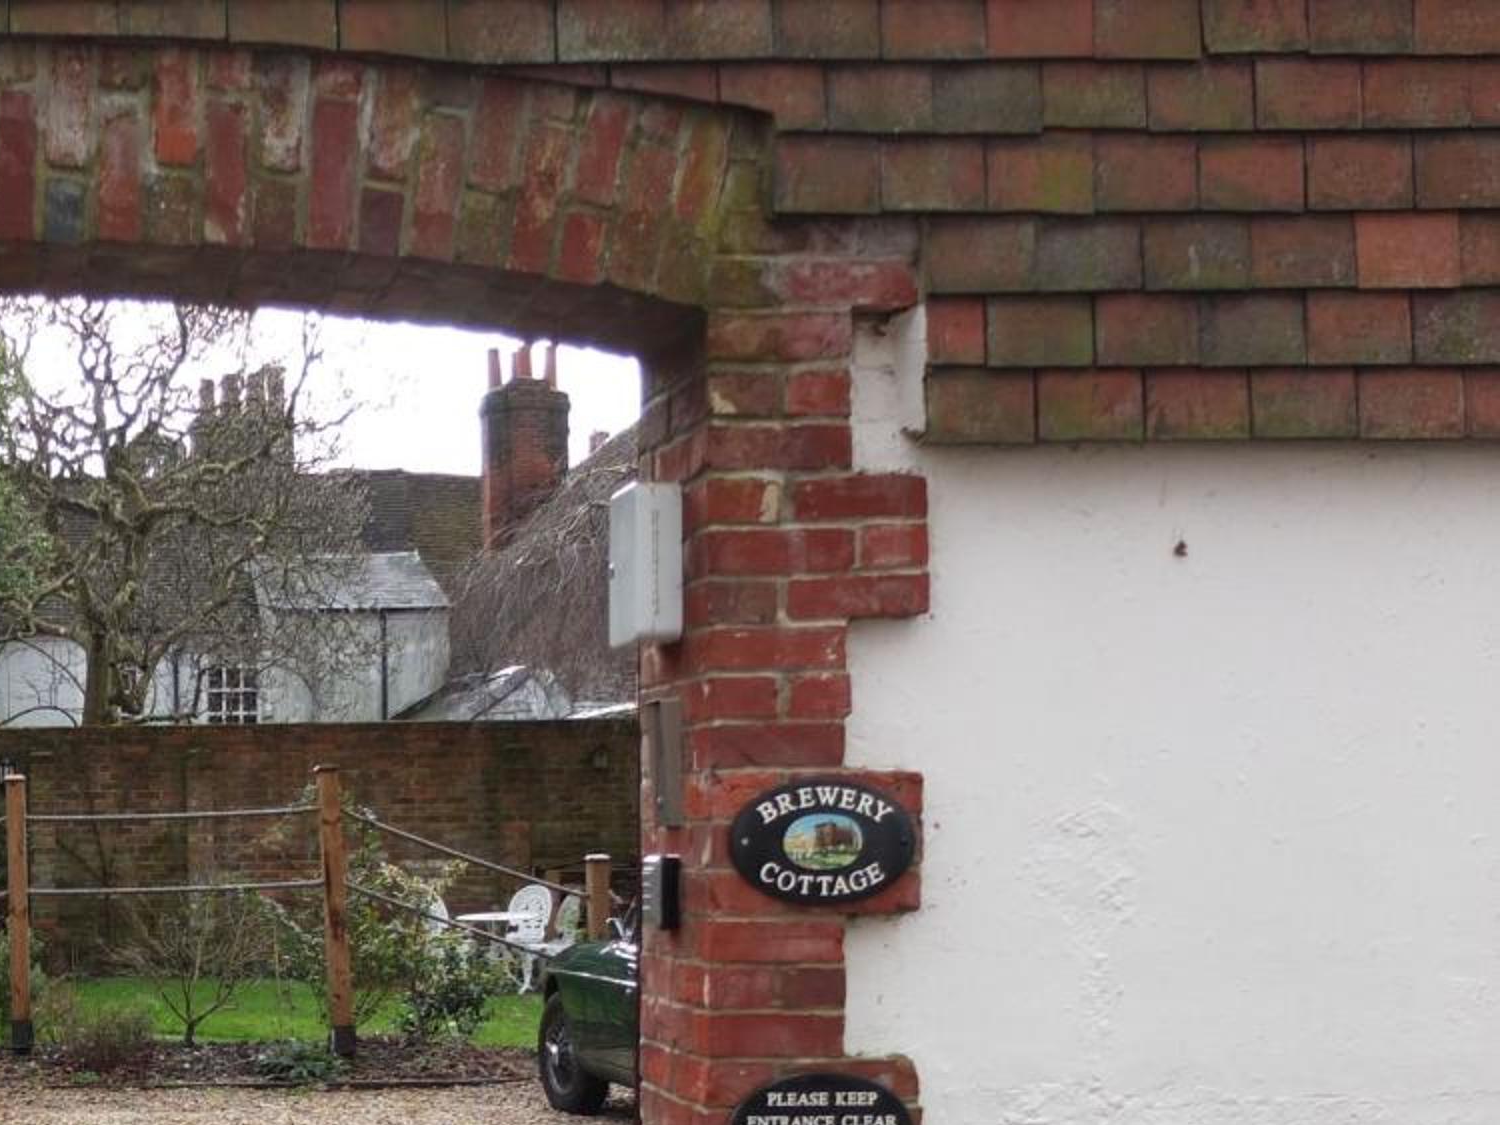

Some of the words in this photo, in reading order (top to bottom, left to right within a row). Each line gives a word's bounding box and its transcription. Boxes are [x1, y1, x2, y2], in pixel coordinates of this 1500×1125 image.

[756, 786, 894, 824] BREWERY
[760, 861, 885, 896] COTTAGE
[767, 1092, 829, 1107] PLEASE
[835, 1091, 878, 1106] KEEP
